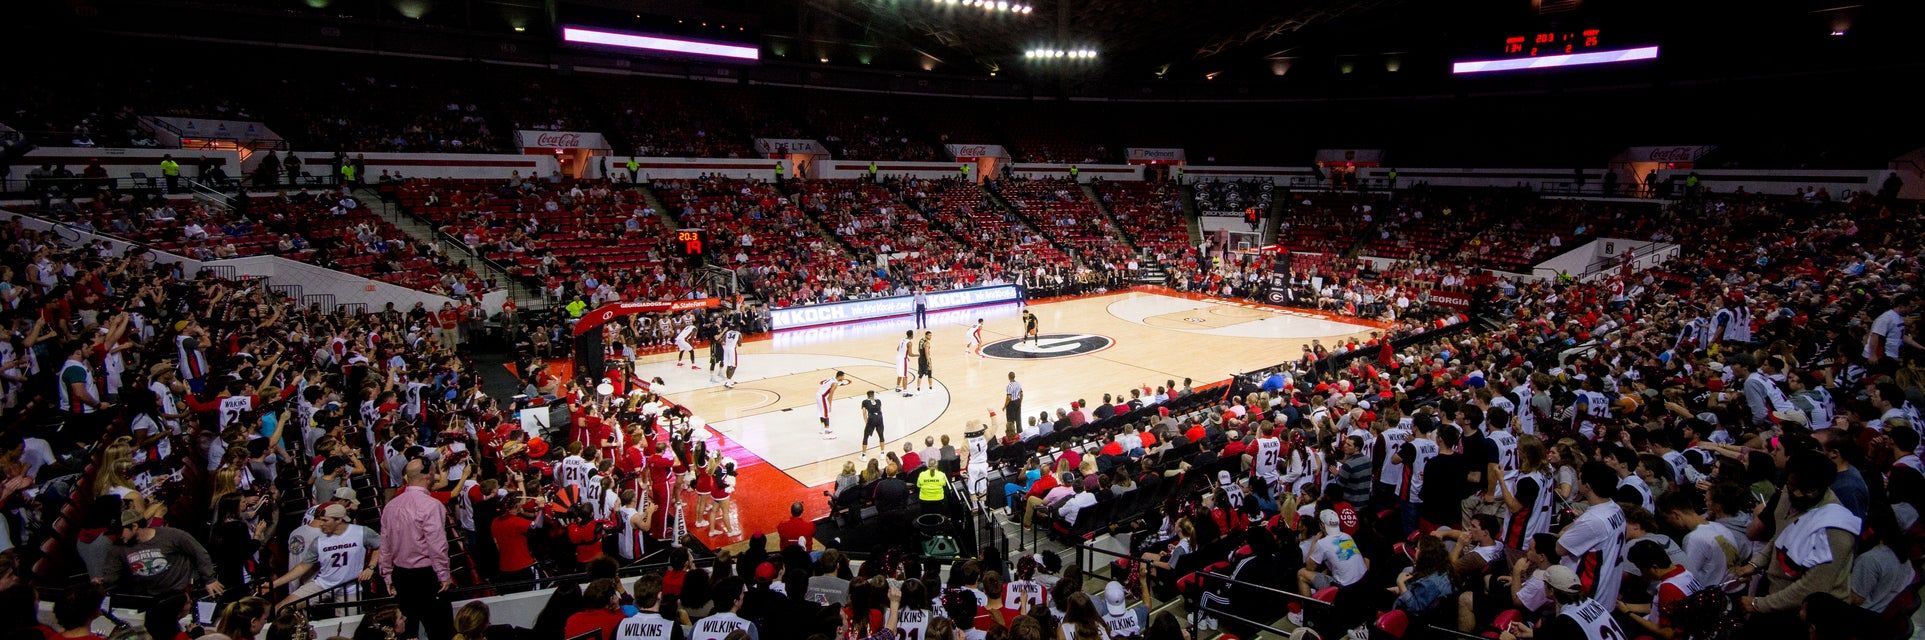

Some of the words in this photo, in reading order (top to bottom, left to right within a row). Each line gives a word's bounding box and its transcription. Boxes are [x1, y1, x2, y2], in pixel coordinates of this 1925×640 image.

[537, 133, 580, 147] Coca-Cola
[774, 142, 811, 151] DELTA
[1144, 150, 1174, 158] Piedmont
[1650, 148, 1690, 161] Coca-Cola
[679, 232, 698, 241] 20.3
[791, 306, 847, 324] KOCH
[1265, 450, 1278, 466] 21
[566, 467, 577, 480] 21
[323, 542, 357, 552] GEORGIA
[331, 551, 348, 568] 21
[624, 623, 662, 637] WILKINS
[703, 620, 741, 633] WILKINS
[1106, 616, 1136, 632] WILKINS
